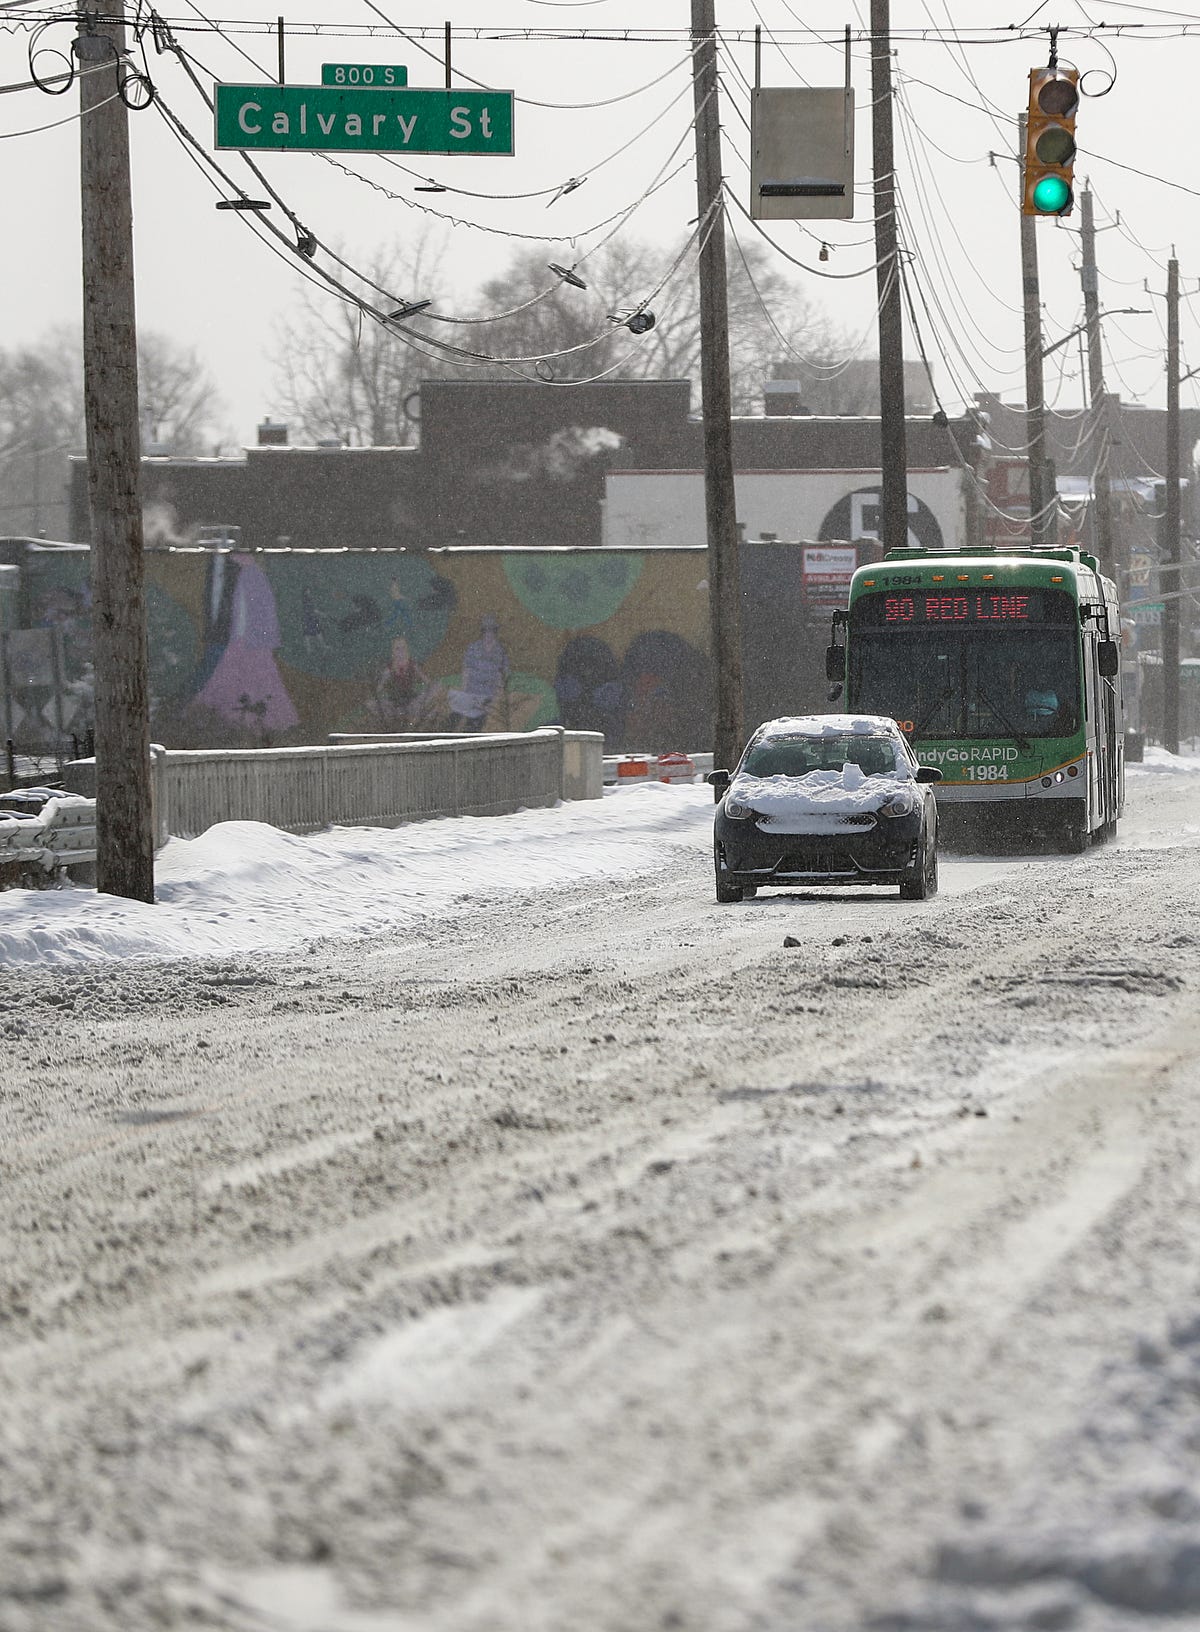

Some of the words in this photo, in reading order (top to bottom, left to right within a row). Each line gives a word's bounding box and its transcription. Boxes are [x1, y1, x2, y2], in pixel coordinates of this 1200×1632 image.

[334, 67, 374, 84] 800
[384, 68, 395, 84] S
[237, 102, 418, 144] Calvary
[449, 106, 494, 139] St
[882, 575, 923, 586] 1984
[885, 598, 914, 621] 90
[926, 596, 968, 620] RED
[976, 596, 1030, 619] LINE
[967, 765, 1009, 781] 1984
